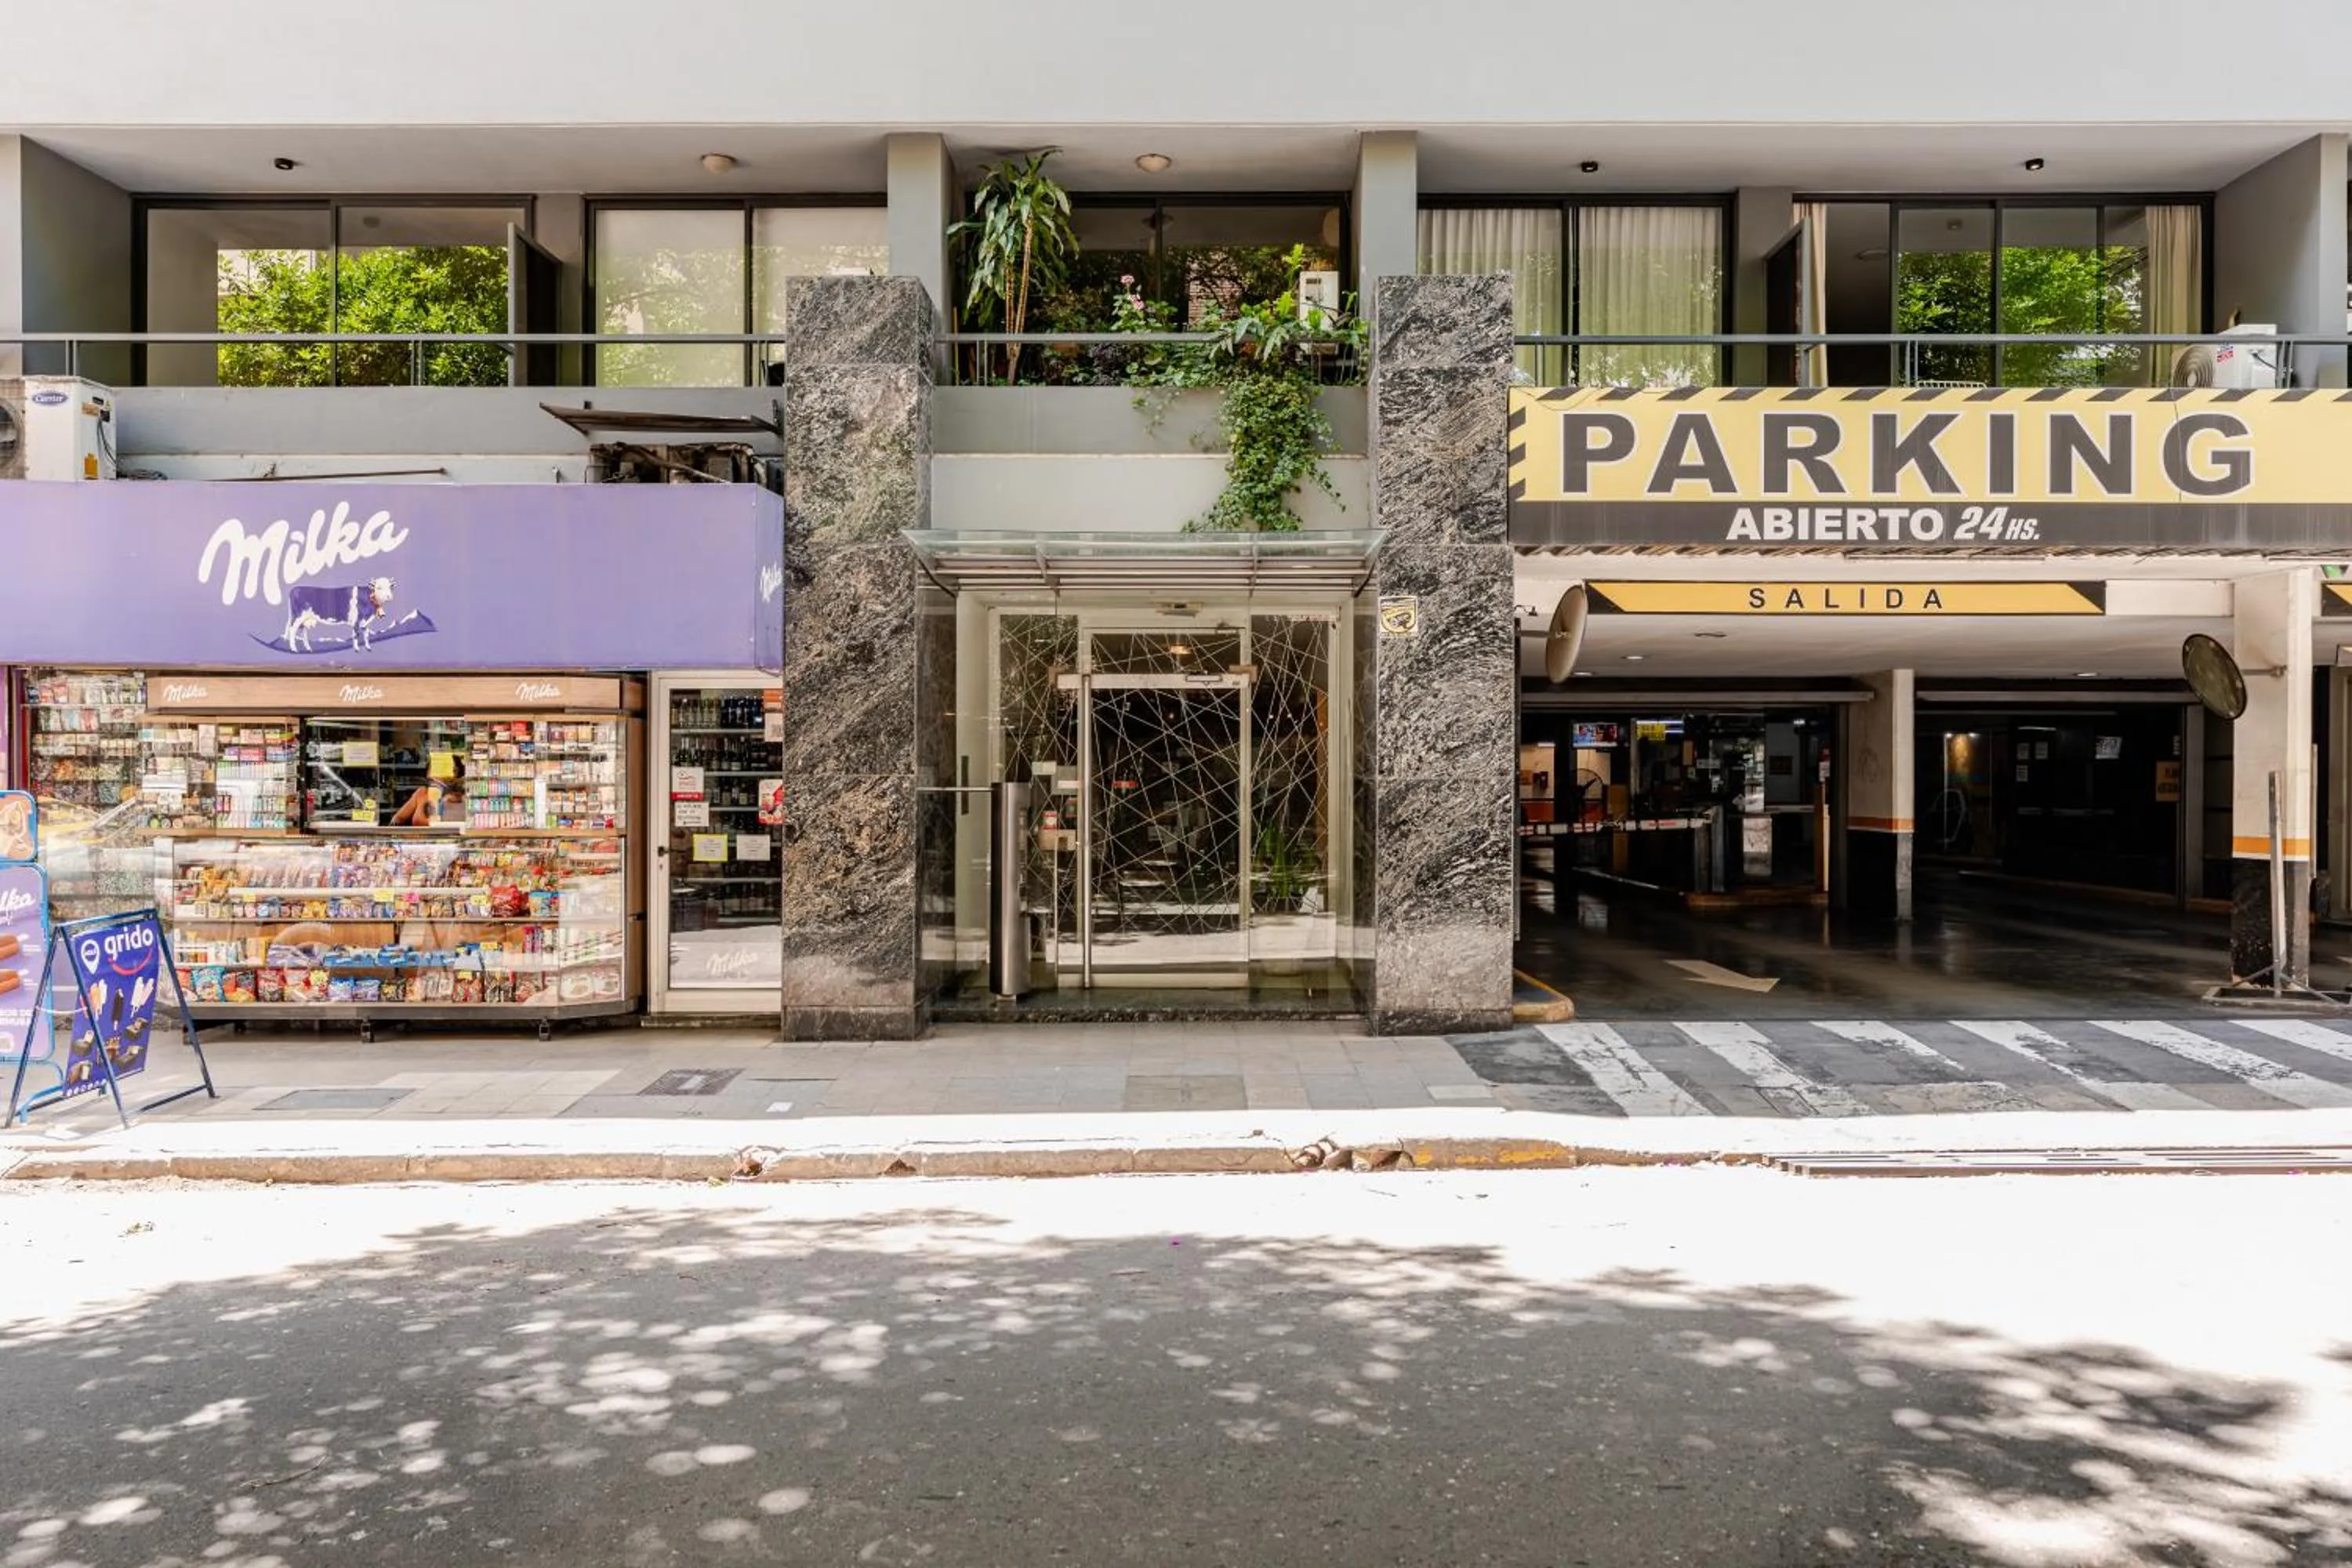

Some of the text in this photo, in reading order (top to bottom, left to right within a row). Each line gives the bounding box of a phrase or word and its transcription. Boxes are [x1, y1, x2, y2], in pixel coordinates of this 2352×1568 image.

[1561, 413, 2254, 495] PARKING
[1726, 506, 1945, 541] ABIERTO
[1953, 506, 2009, 541] 24
[198, 500, 409, 606] Milka
[1748, 587, 1942, 609] SALIDA
[163, 684, 209, 702] Milka
[339, 684, 384, 702] Milka
[515, 682, 561, 702] Milka
[103, 924, 154, 962] grido
